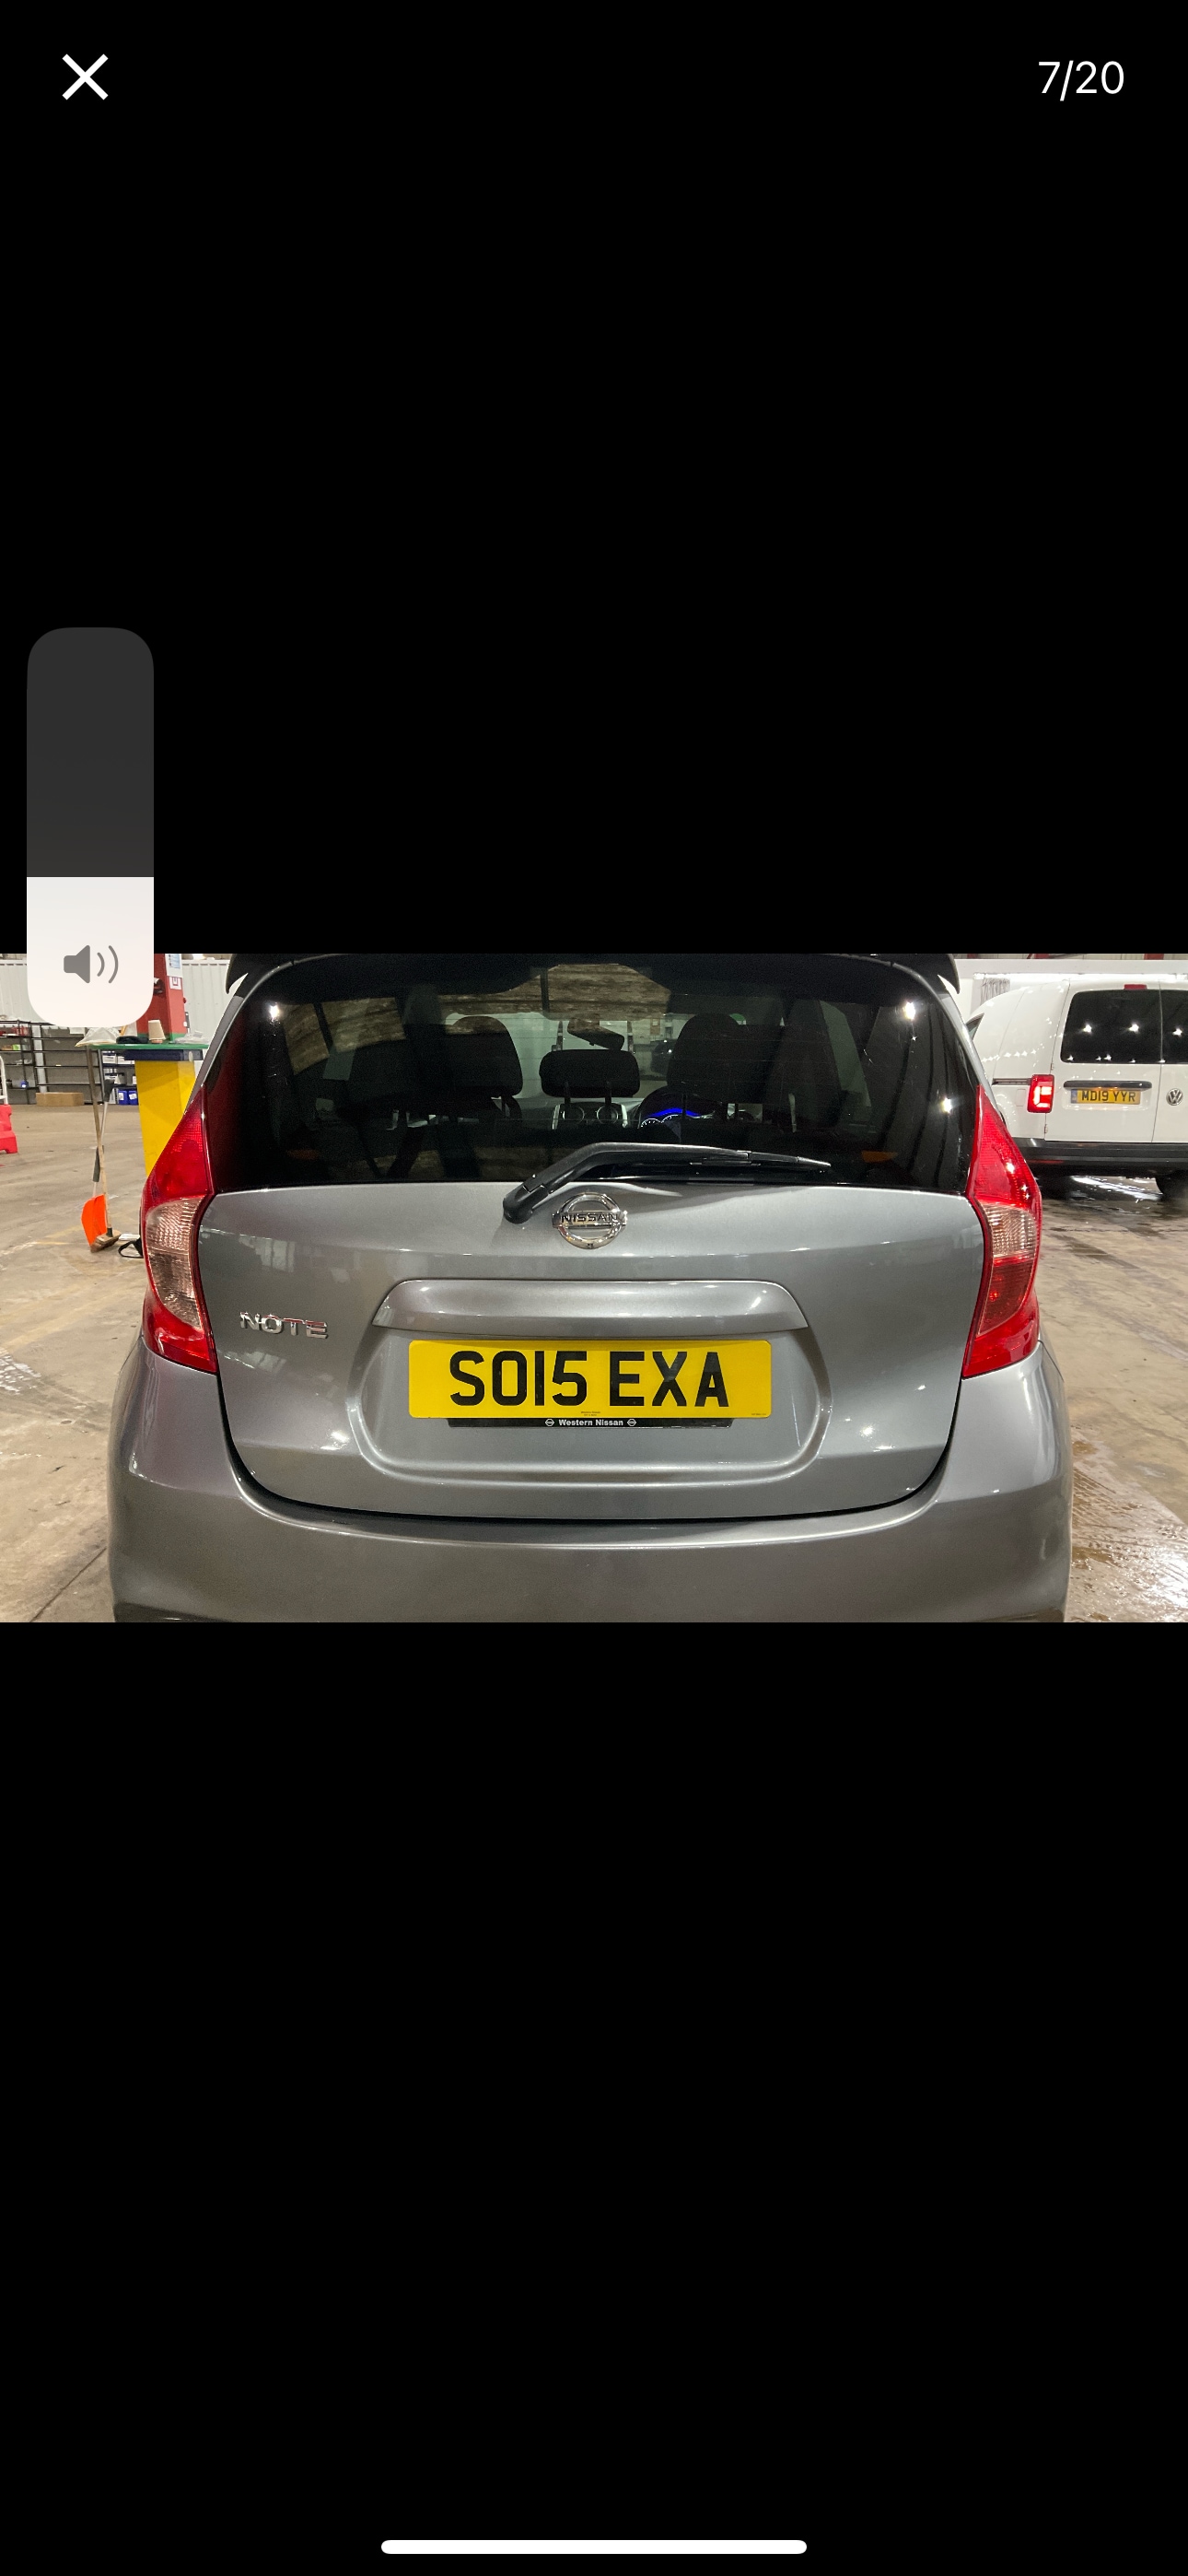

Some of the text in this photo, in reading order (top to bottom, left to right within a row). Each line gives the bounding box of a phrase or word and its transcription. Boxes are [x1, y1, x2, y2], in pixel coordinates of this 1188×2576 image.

[1081, 1090, 1136, 1103] MD19 YYR
[561, 1212, 618, 1223] NISSAN
[239, 1311, 328, 1339] NOTE
[449, 1351, 729, 1407] SO15 EXA
